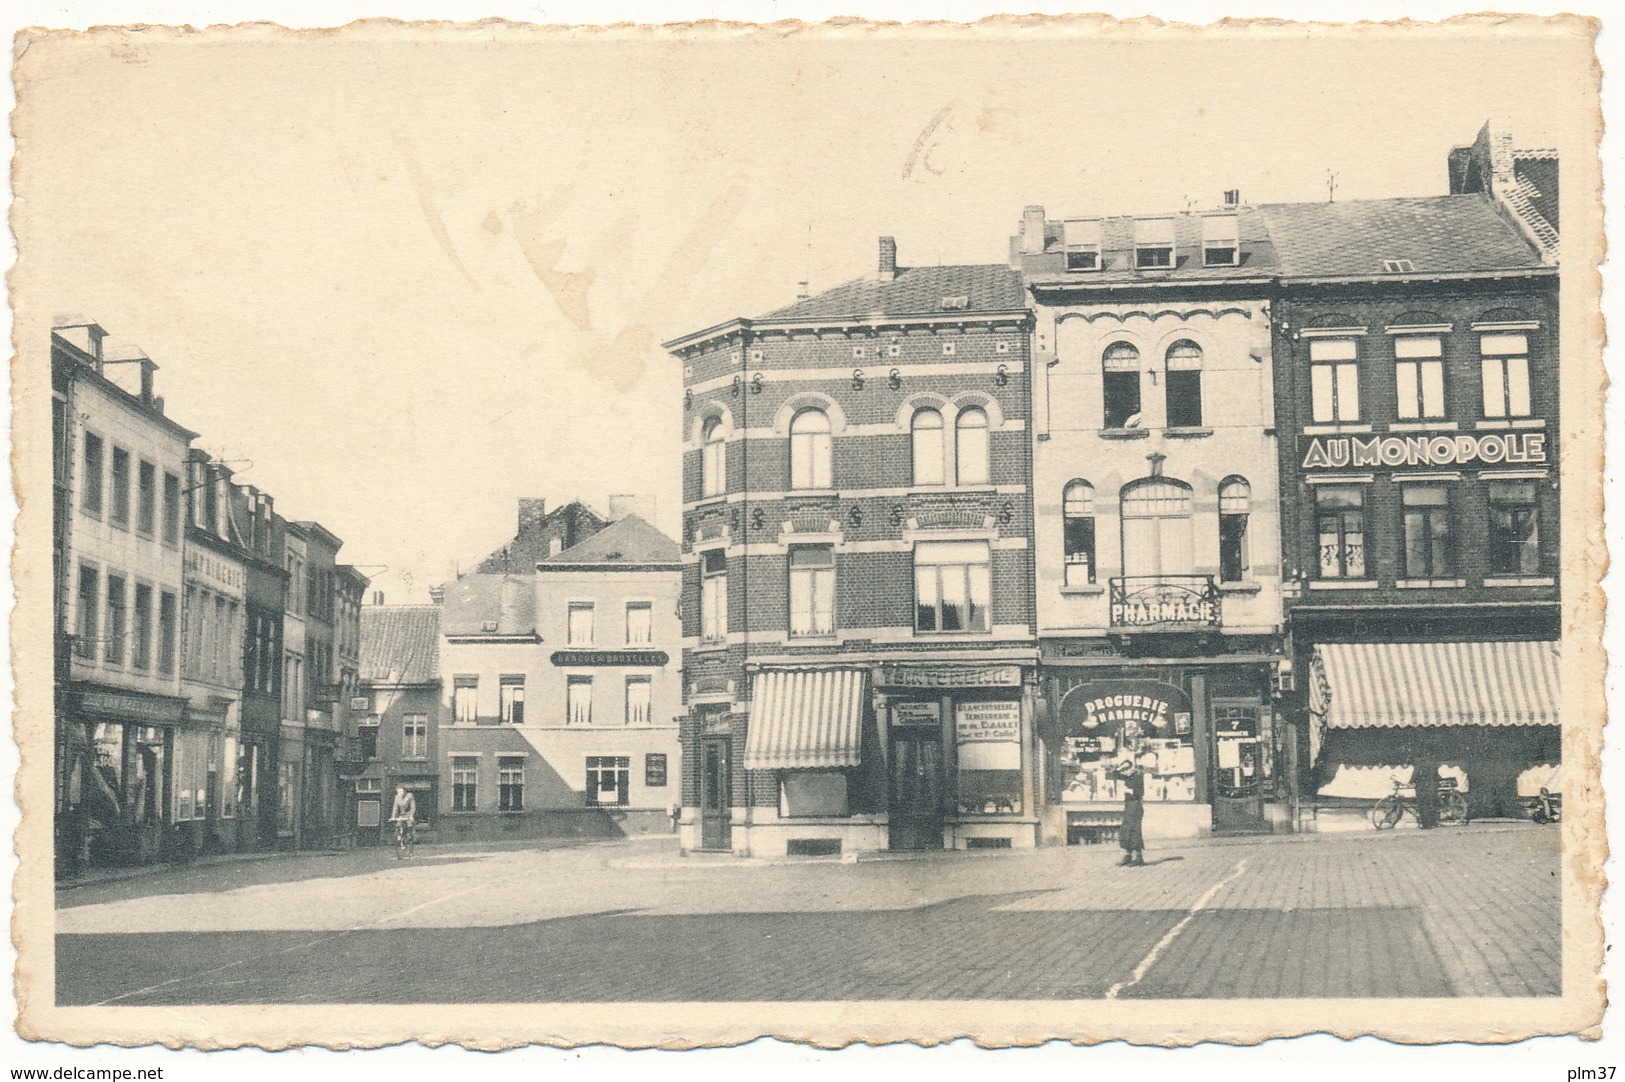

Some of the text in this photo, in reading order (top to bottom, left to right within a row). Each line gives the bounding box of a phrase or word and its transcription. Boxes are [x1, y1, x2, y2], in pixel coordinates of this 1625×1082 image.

[1302, 433, 1547, 468] AU MONOPOLE
[1111, 602, 1216, 622] PHARMACIE
[558, 655, 597, 663] BANQUE
[606, 655, 663, 663] BRUXELLES
[882, 668, 1011, 685] TEINTURERIE
[1085, 695, 1169, 714] DROGUERIE
[1092, 710, 1163, 725] HARMACI
[1231, 720, 1240, 730] 7
